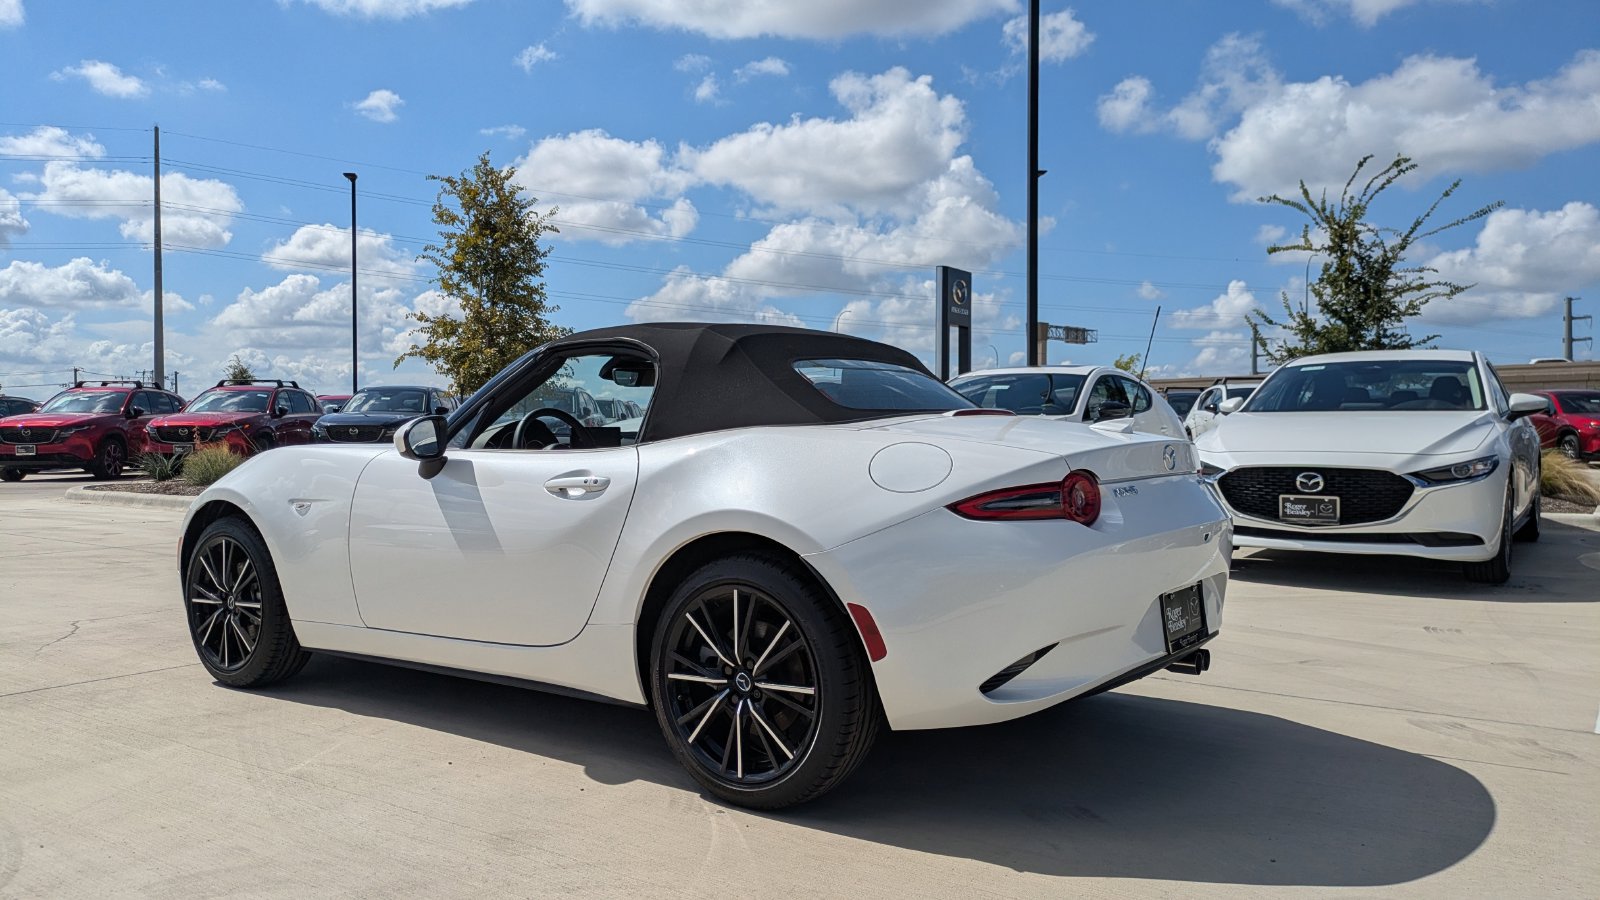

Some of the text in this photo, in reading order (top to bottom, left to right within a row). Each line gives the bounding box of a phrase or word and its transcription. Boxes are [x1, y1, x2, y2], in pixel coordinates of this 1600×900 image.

[1284, 508, 1311, 517] Beasley
[1166, 607, 1182, 621] Roger
[1168, 617, 1187, 633] Beasley
